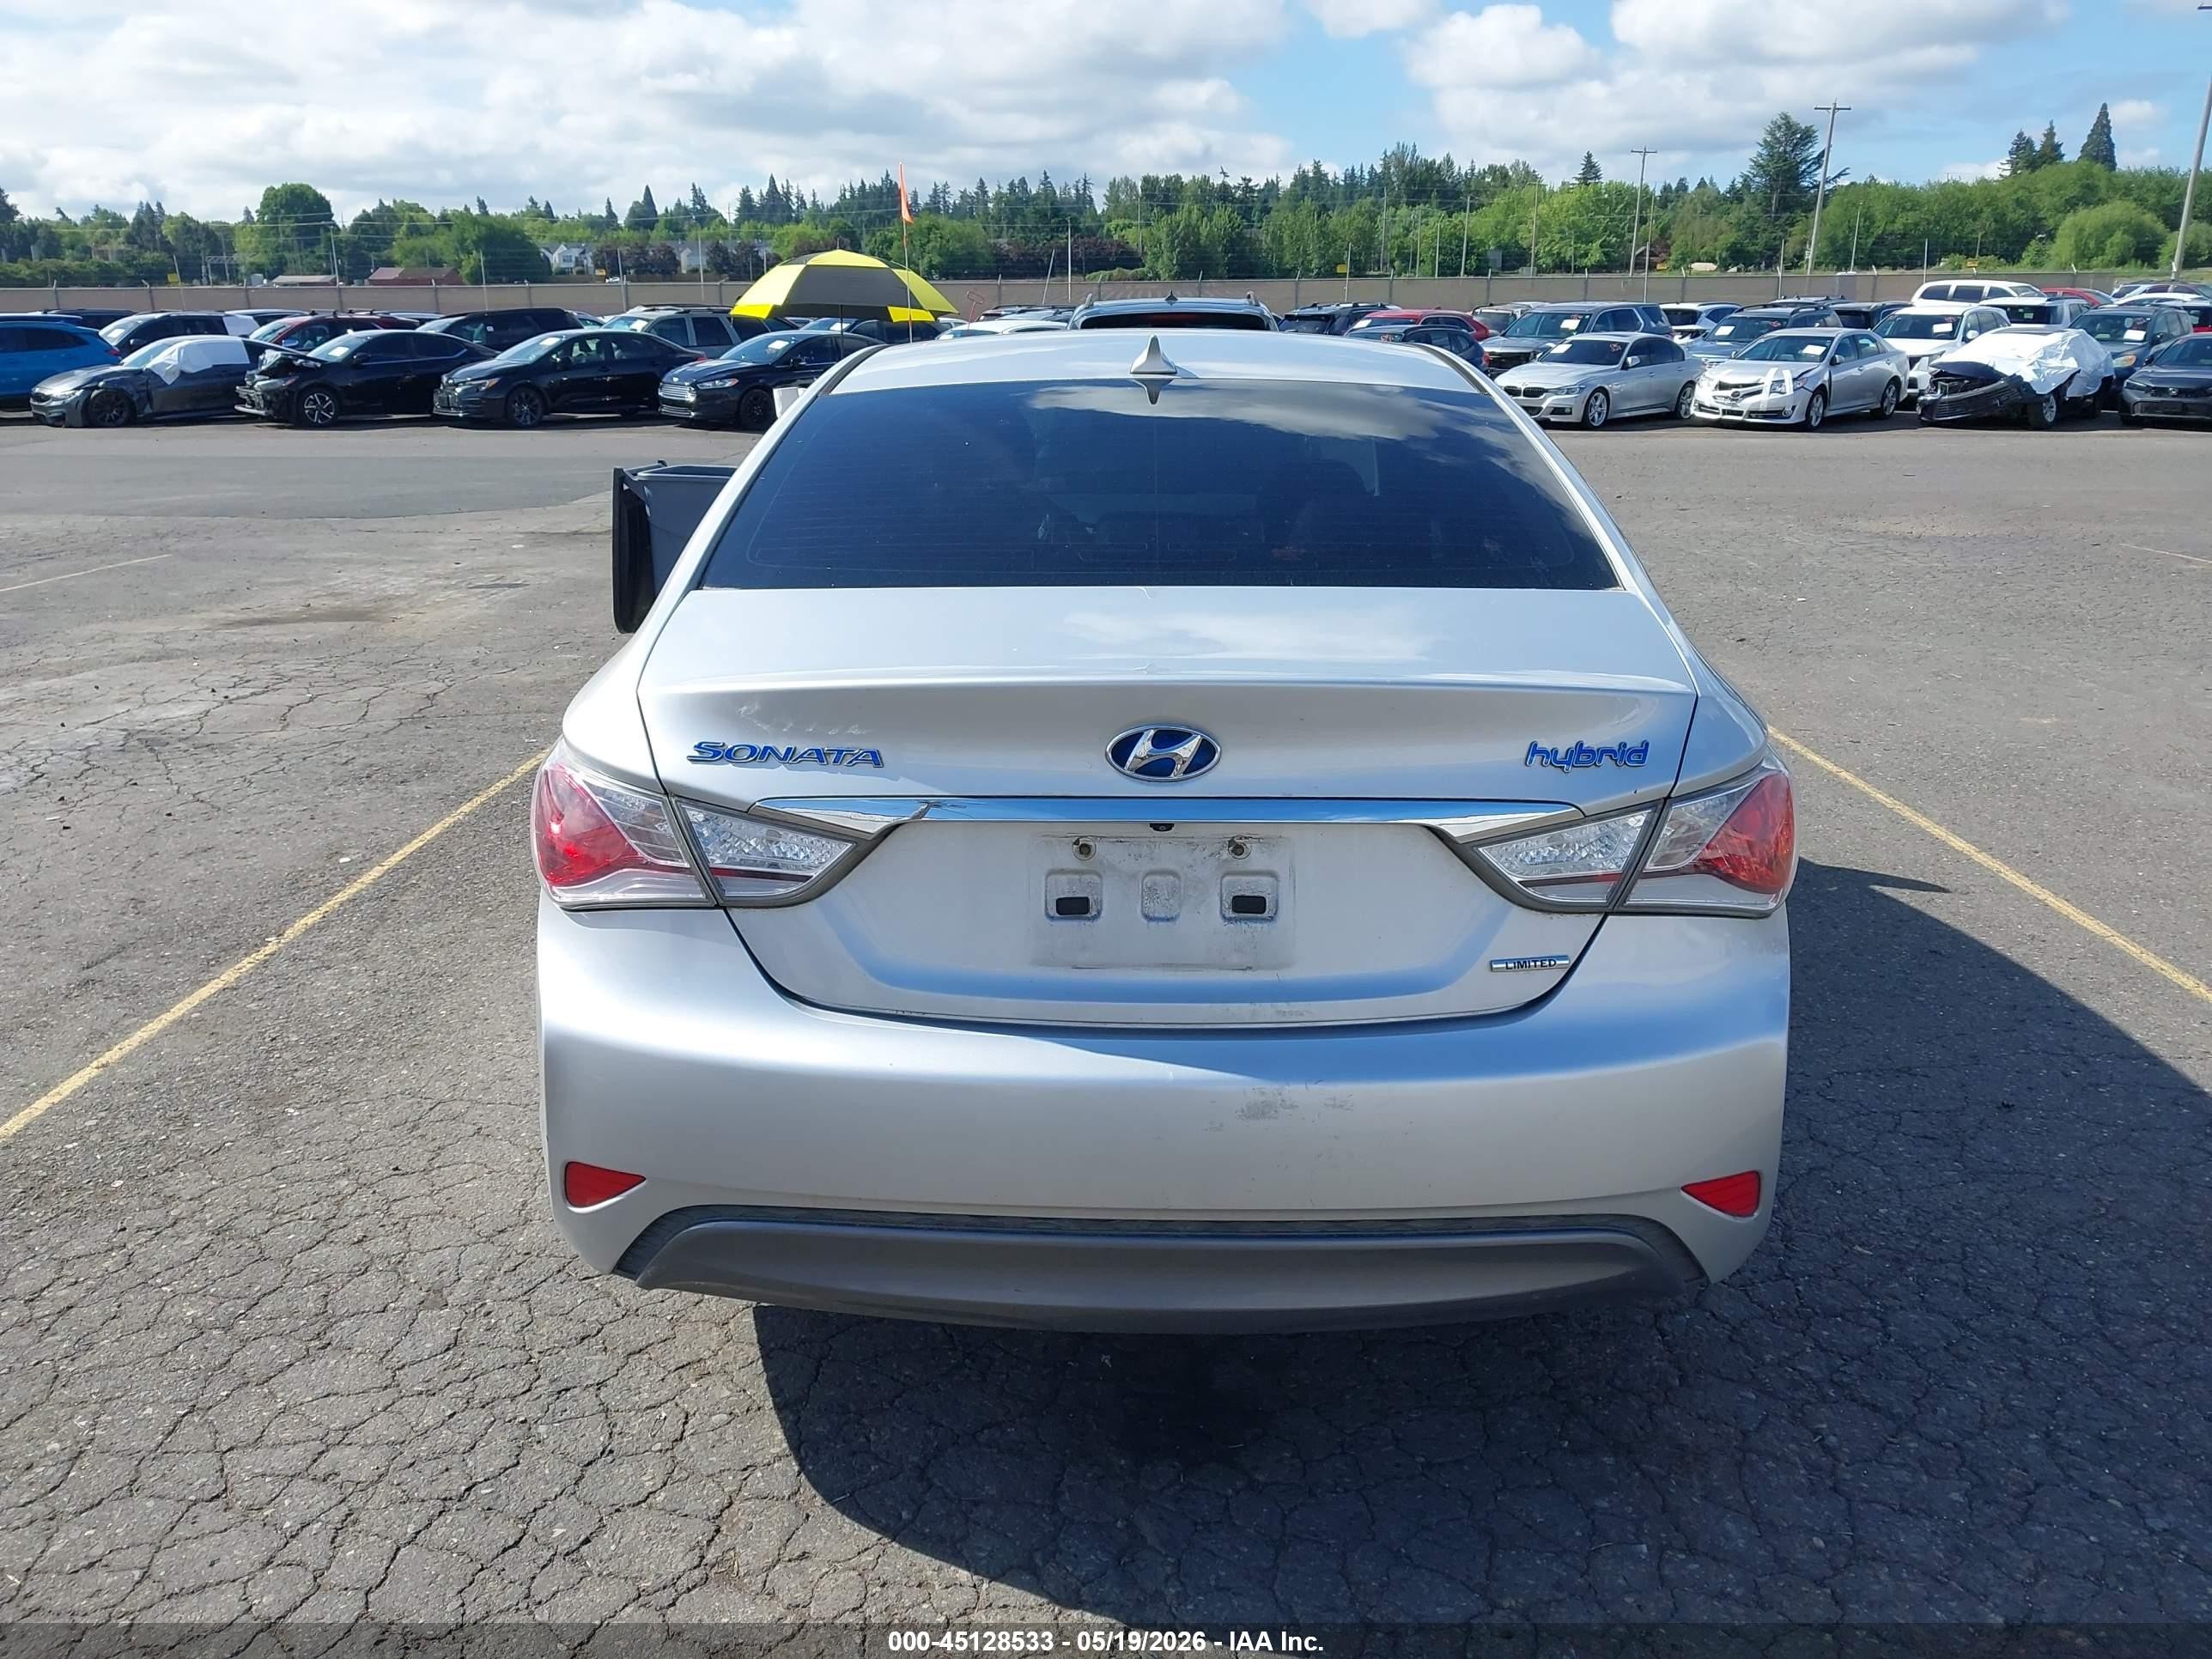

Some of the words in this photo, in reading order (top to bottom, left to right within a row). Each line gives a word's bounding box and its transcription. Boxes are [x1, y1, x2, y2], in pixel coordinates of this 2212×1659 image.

[687, 741, 884, 768] SONATA
[1525, 740, 1650, 773] hybrid
[1505, 958, 1557, 969] LIMITED
